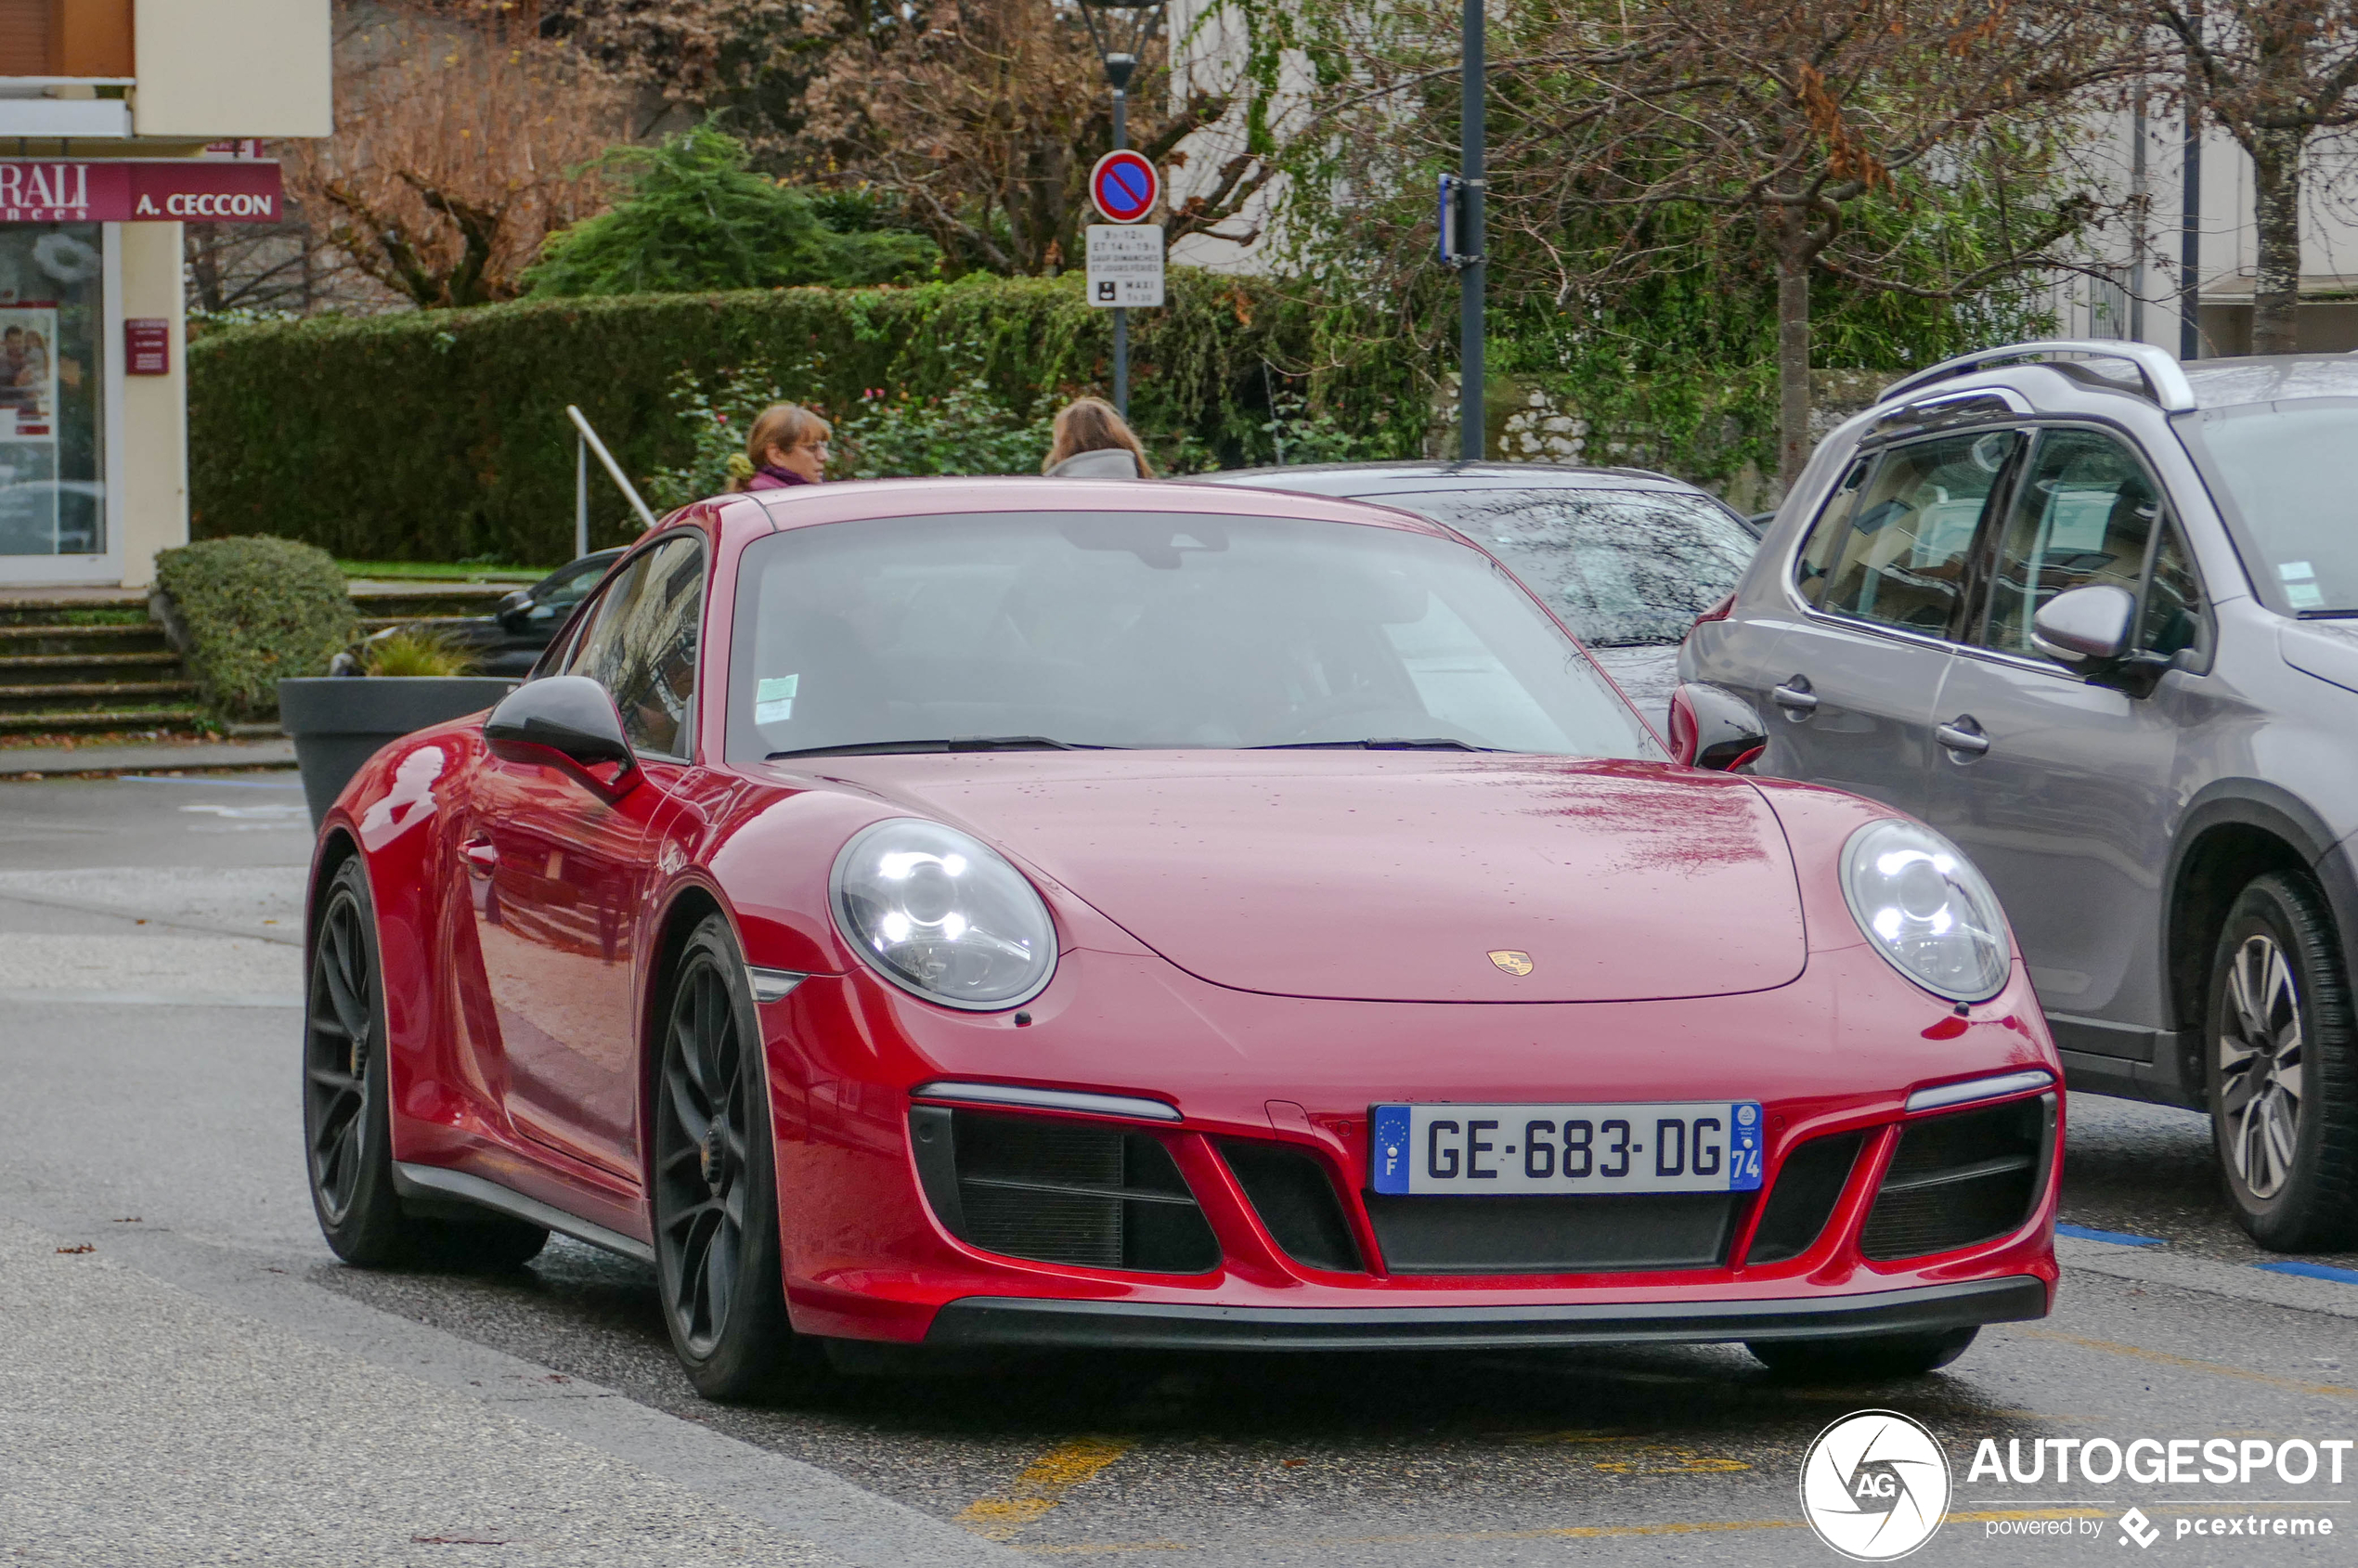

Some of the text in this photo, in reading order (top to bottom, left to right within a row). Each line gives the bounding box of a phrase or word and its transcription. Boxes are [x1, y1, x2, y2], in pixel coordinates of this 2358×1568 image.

[0, 164, 90, 208] RALI
[136, 193, 272, 215] A. CECCON
[1428, 1119, 1721, 1179] GE-683-DG
[1386, 1159, 1398, 1176] F
[1731, 1150, 1760, 1178] 74
